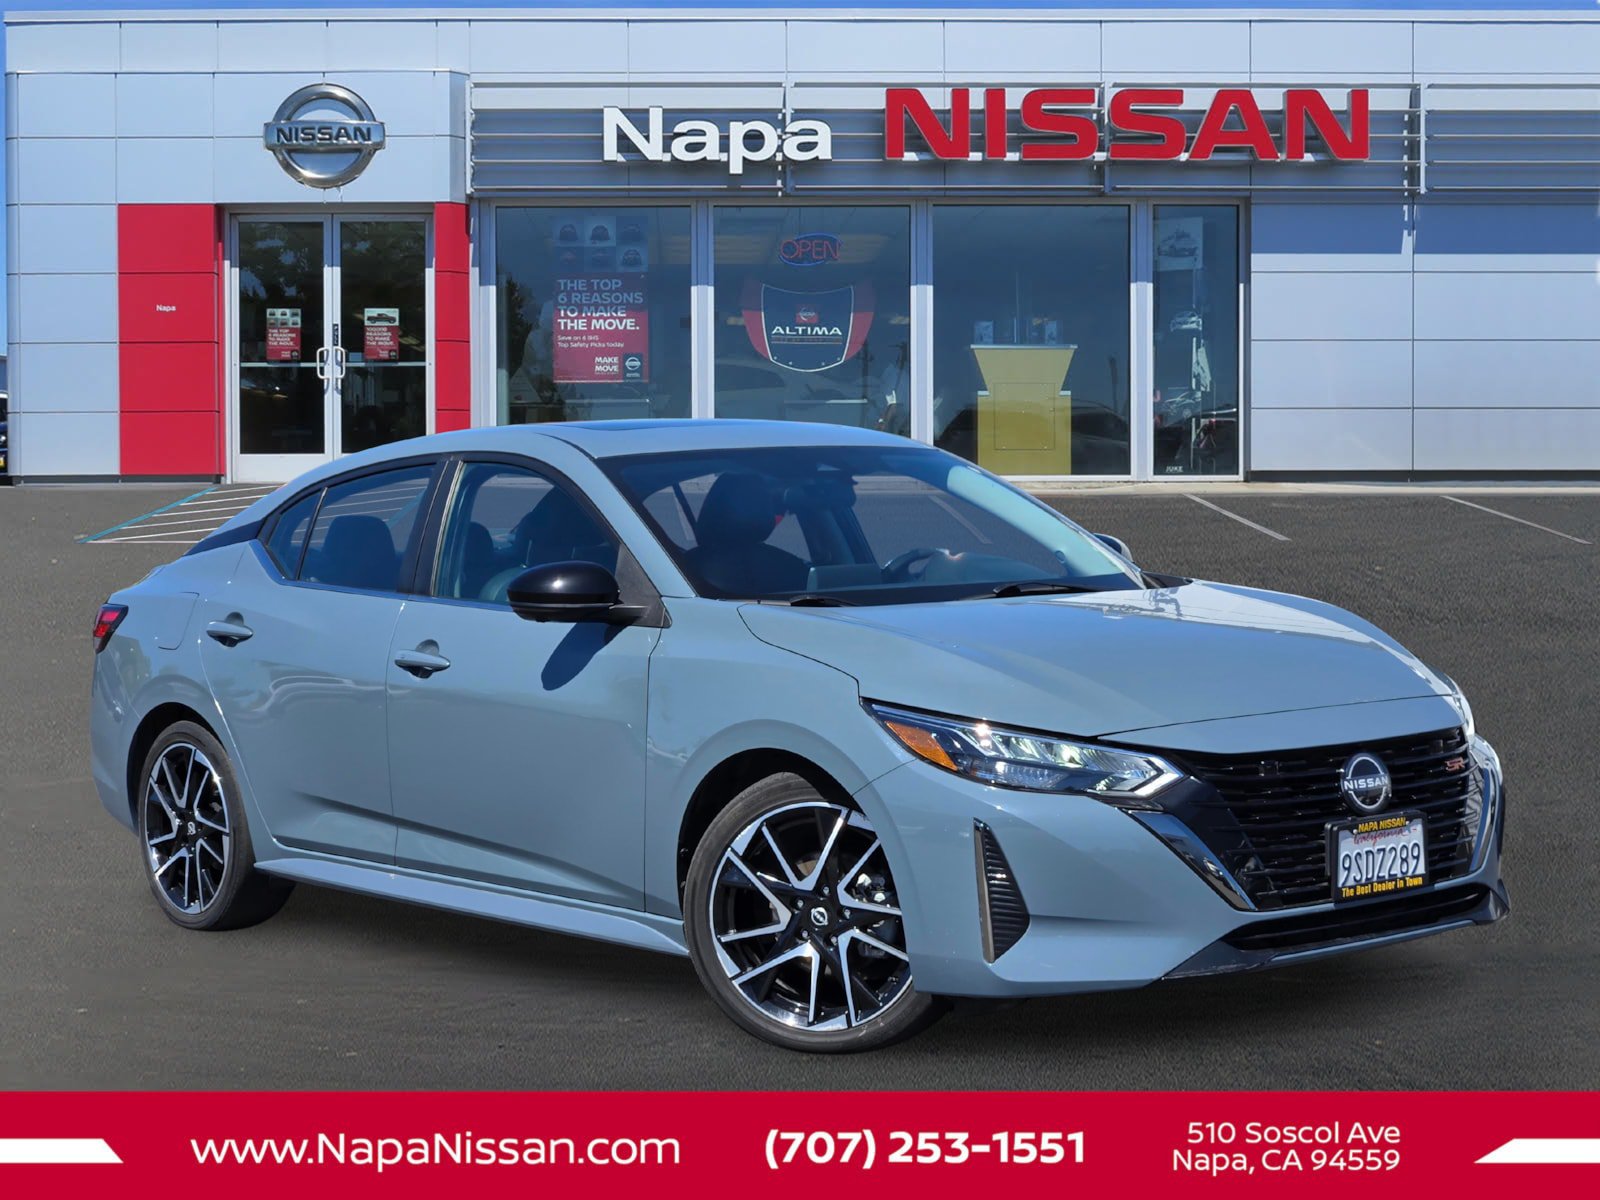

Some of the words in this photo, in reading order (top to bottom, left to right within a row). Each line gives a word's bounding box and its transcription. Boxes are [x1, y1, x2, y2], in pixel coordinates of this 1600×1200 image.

[276, 126, 372, 143] NISSAN
[602, 107, 833, 175] Napa
[885, 87, 1371, 163] NISSAN
[781, 239, 841, 260] OPEN
[557, 279, 588, 291] THE
[590, 279, 622, 291] TOP
[557, 292, 568, 304] 6
[571, 292, 644, 304] REASONS
[156, 304, 176, 312] Napa
[557, 306, 579, 317] TO
[582, 306, 627, 317] MAKE
[557, 319, 588, 330] THE
[591, 319, 640, 330] MOVE.
[771, 326, 842, 335] ALTIMA
[1445, 757, 1466, 772] SR
[1344, 775, 1388, 791] NISSAN
[1358, 821, 1379, 833] NAPA
[1379, 817, 1406, 831] NISSAN
[1341, 842, 1421, 887] 9SDZ289
[1342, 886, 1355, 898] The
[1356, 883, 1372, 895] Best
[1373, 880, 1396, 892] Dealer
[1397, 878, 1404, 890] in
[1405, 876, 1423, 887] Town
